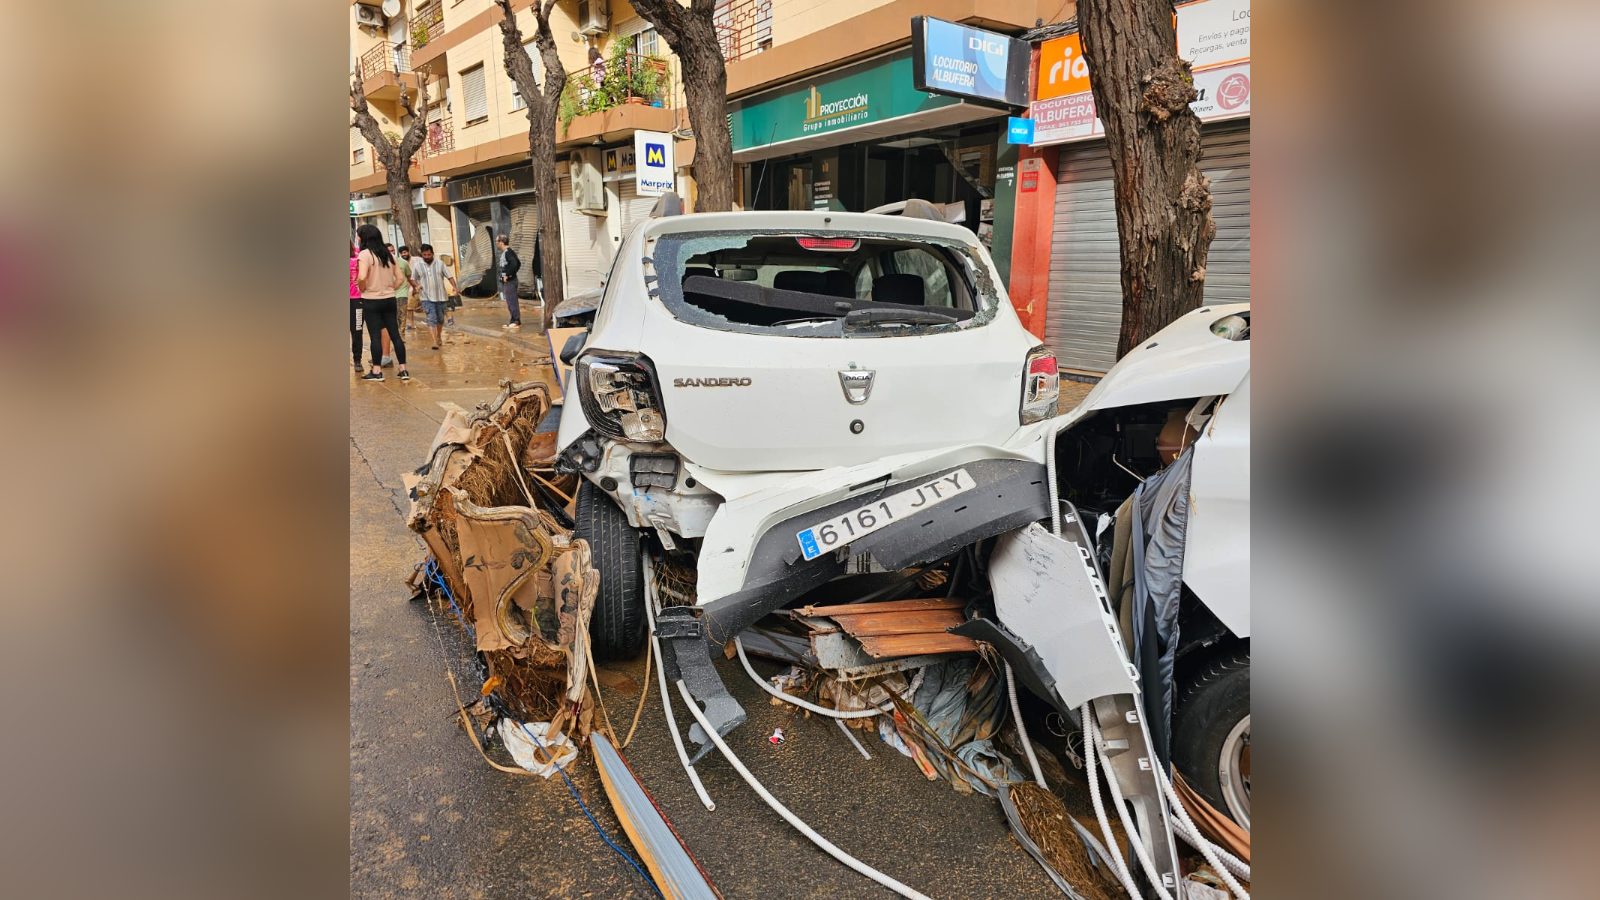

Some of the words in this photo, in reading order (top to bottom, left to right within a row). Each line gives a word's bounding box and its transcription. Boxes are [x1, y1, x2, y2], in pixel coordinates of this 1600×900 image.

[968, 36, 1004, 55] DIGI
[1190, 43, 1224, 55] Recargas,
[1227, 38, 1248, 48] venta
[933, 55, 978, 75] LOCUTORIO
[1049, 46, 1089, 84] ria
[932, 69, 975, 88] ALBUFERA
[820, 93, 868, 116] PROYECCIÓN
[1034, 104, 1094, 123] ALBUFERA
[803, 122, 823, 132] Grupo
[824, 110, 868, 127] inmobiliario
[608, 155, 616, 169] M
[647, 146, 664, 165] M
[461, 180, 482, 199] Black
[490, 175, 516, 194] White
[641, 179, 673, 189] Marprix
[1007, 179, 1013, 187] 7
[355, 308, 363, 331] PUMA
[673, 377, 752, 388] SANDERO
[819, 501, 893, 546] 6161
[911, 473, 962, 508] JTY
[807, 545, 816, 554] E
